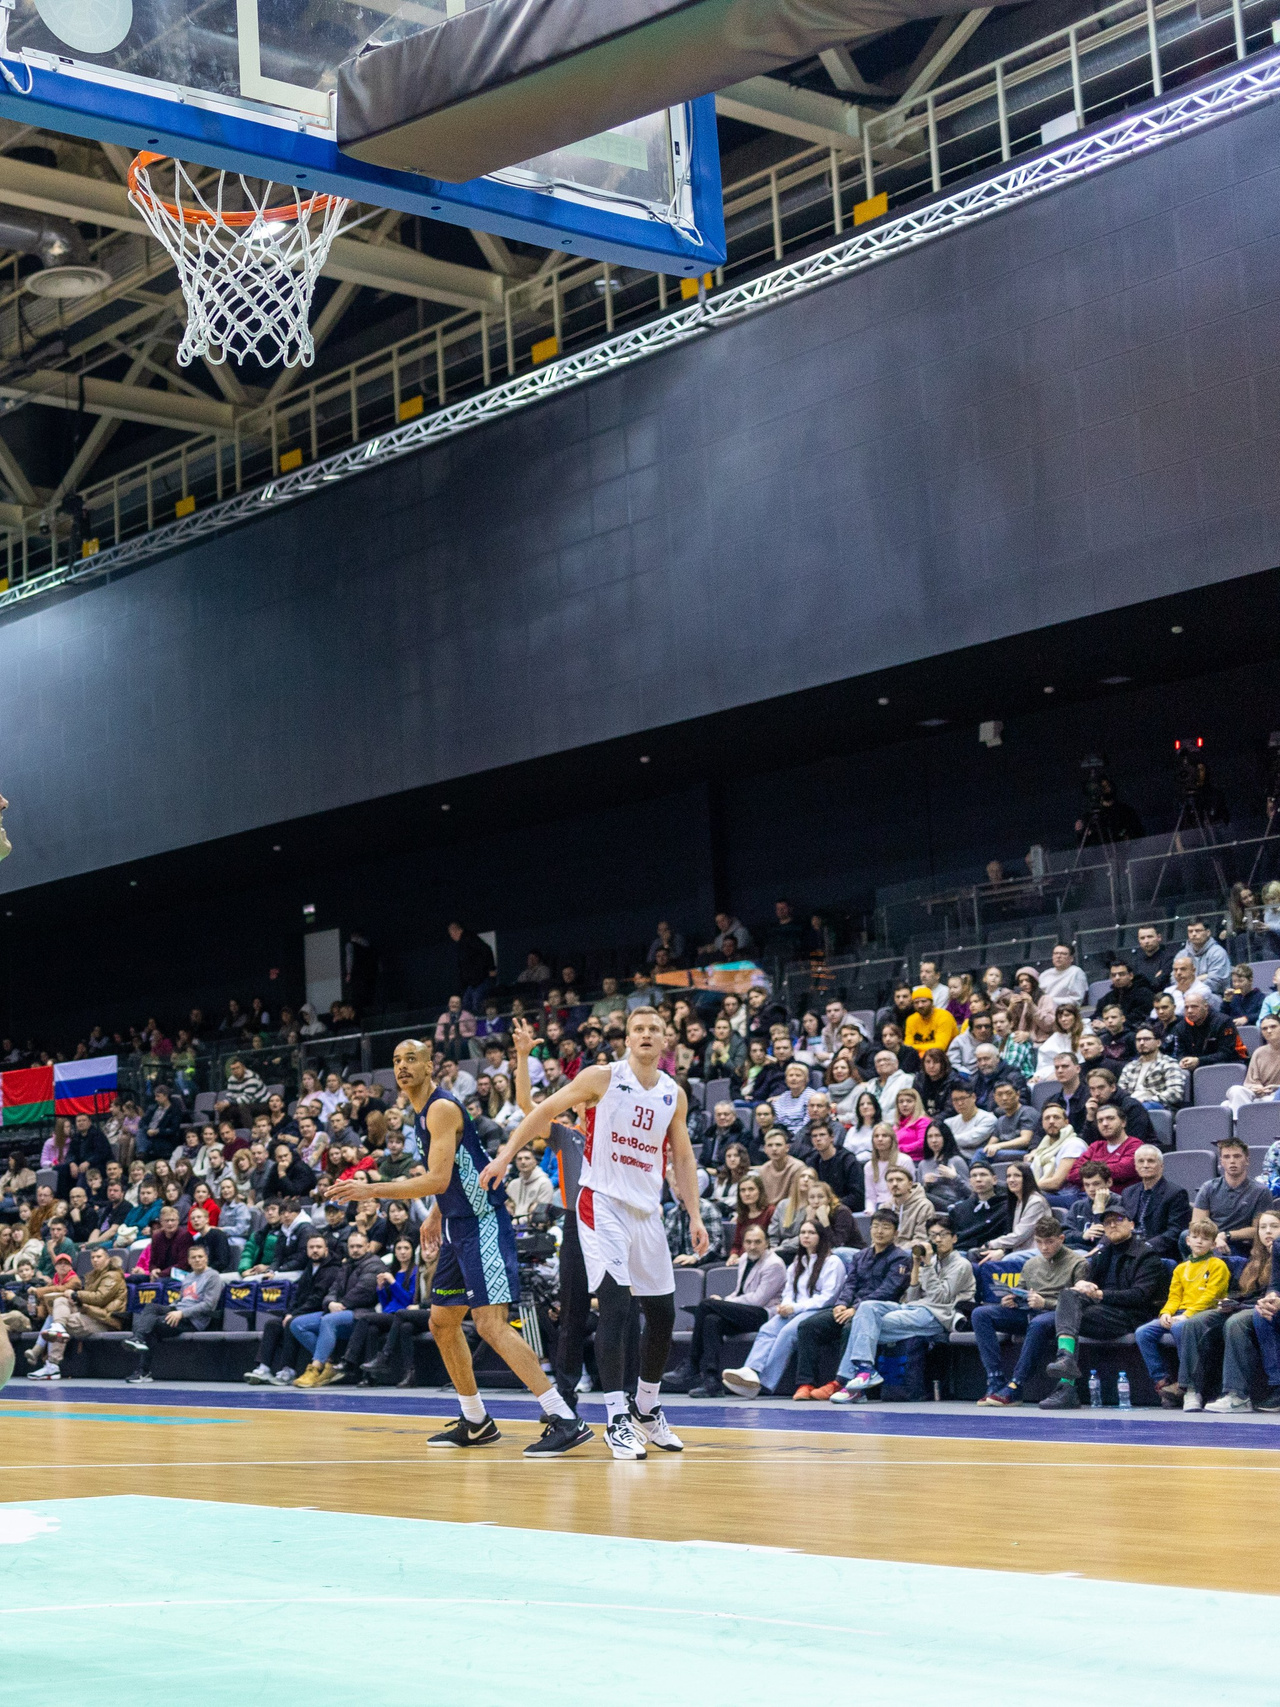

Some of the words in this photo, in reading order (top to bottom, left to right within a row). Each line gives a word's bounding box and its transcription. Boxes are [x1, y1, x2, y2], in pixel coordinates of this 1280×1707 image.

[632, 1105, 655, 1131] 33
[611, 1131, 659, 1155] BetBoom
[138, 1290, 157, 1304] VIP
[230, 1287, 251, 1300] VIP
[261, 1287, 282, 1302] VIP
